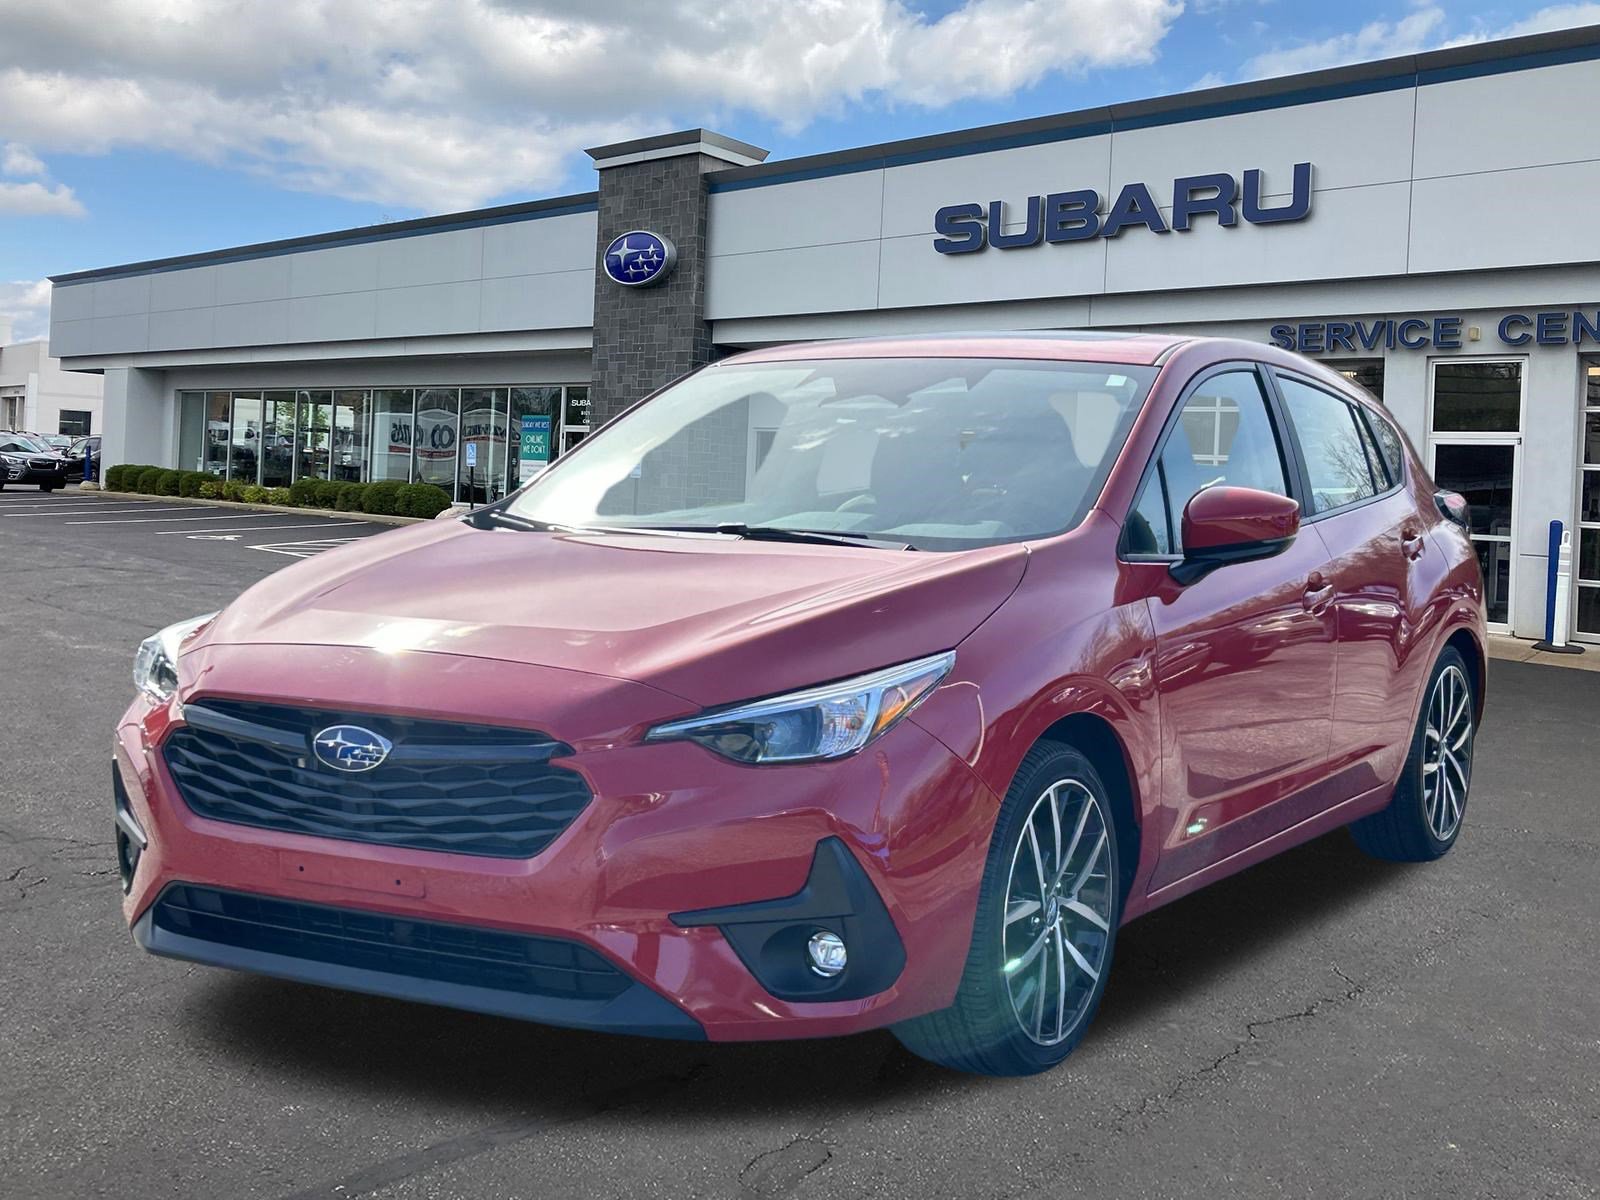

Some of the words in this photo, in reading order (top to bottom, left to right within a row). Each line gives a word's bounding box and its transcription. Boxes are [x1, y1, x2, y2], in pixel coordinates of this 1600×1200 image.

[934, 162, 1312, 255] SUBARU
[1270, 317, 1463, 352] SERVICE
[1498, 311, 1600, 345] CEN
[571, 399, 591, 407] SUBA
[522, 445, 530, 453] WE
